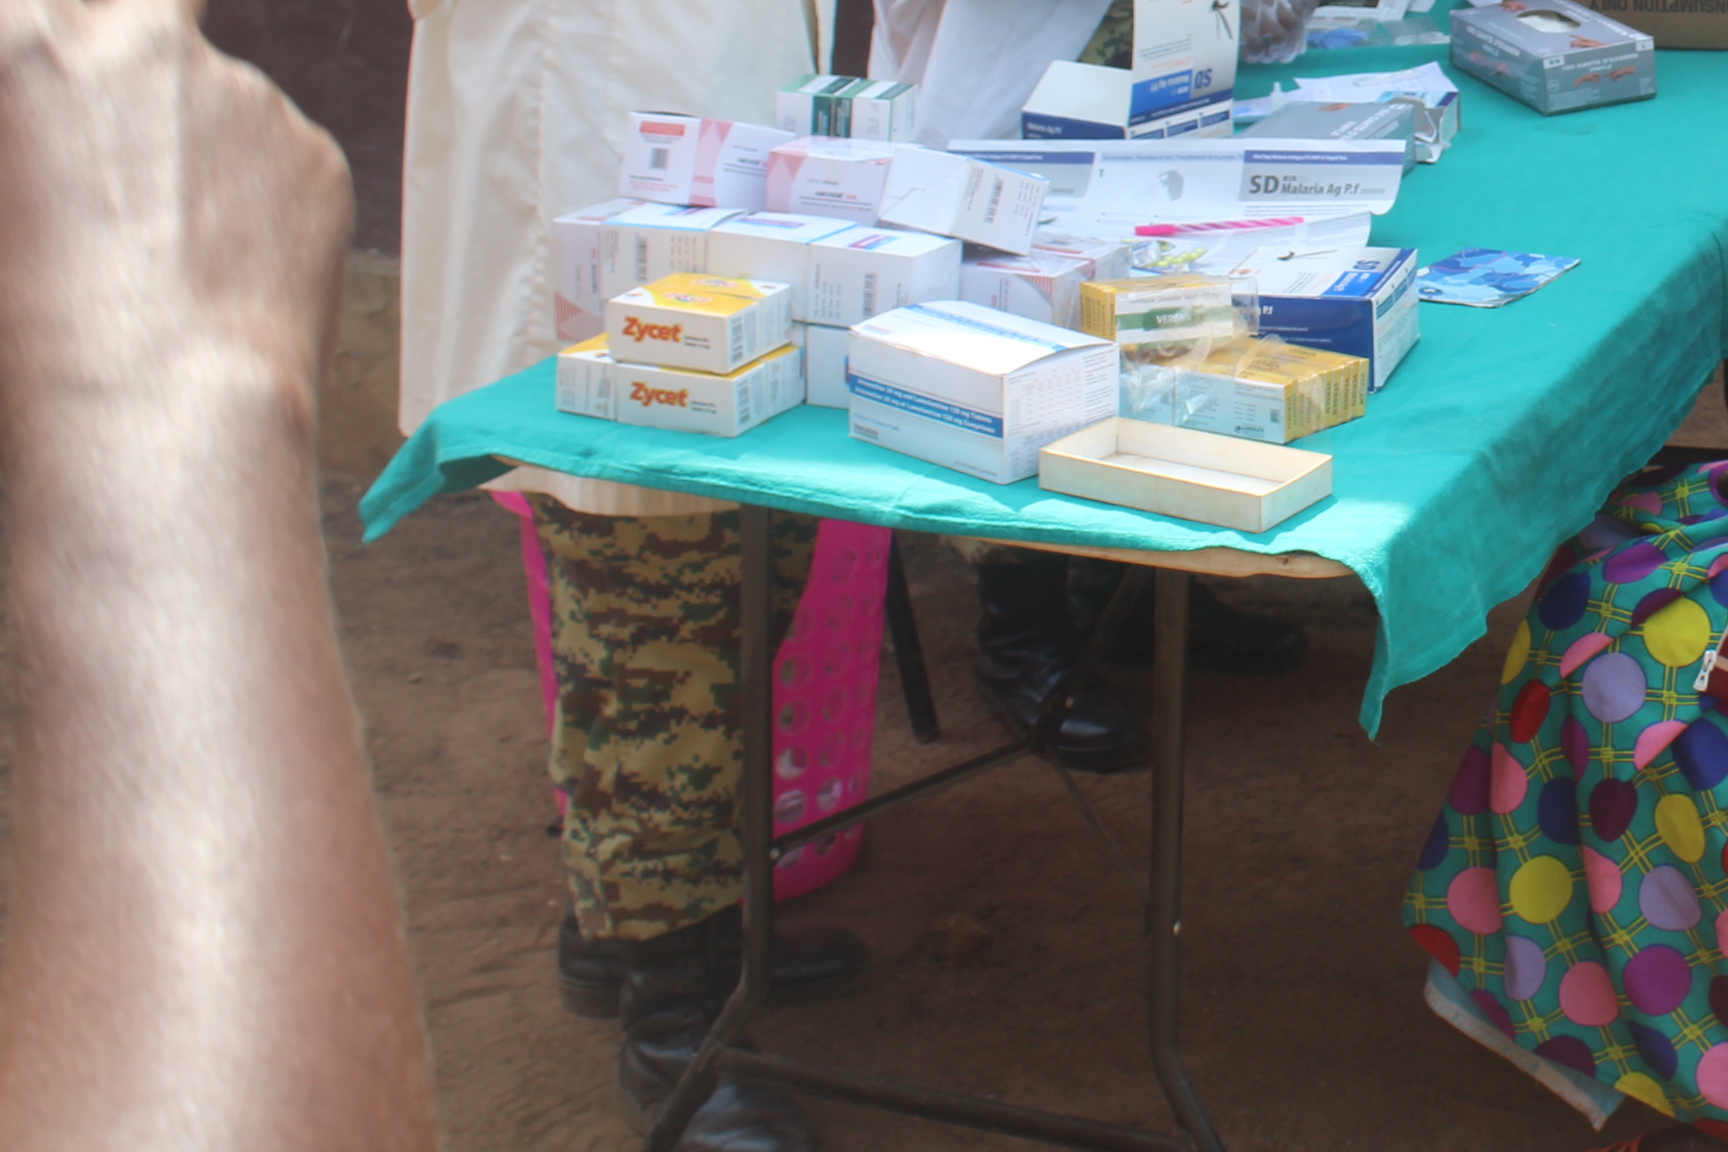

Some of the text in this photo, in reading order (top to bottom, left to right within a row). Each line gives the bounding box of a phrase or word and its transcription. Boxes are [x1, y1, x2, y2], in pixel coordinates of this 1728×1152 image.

[1194, 68, 1213, 90] SD
[1250, 175, 1280, 194] SD
[1281, 183, 1324, 194] Malaria
[1326, 184, 1341, 197] Ag
[1343, 183, 1360, 194] P.f
[1353, 259, 1380, 270] SD
[622, 316, 684, 343] Zycet
[629, 381, 689, 408] Zycet
